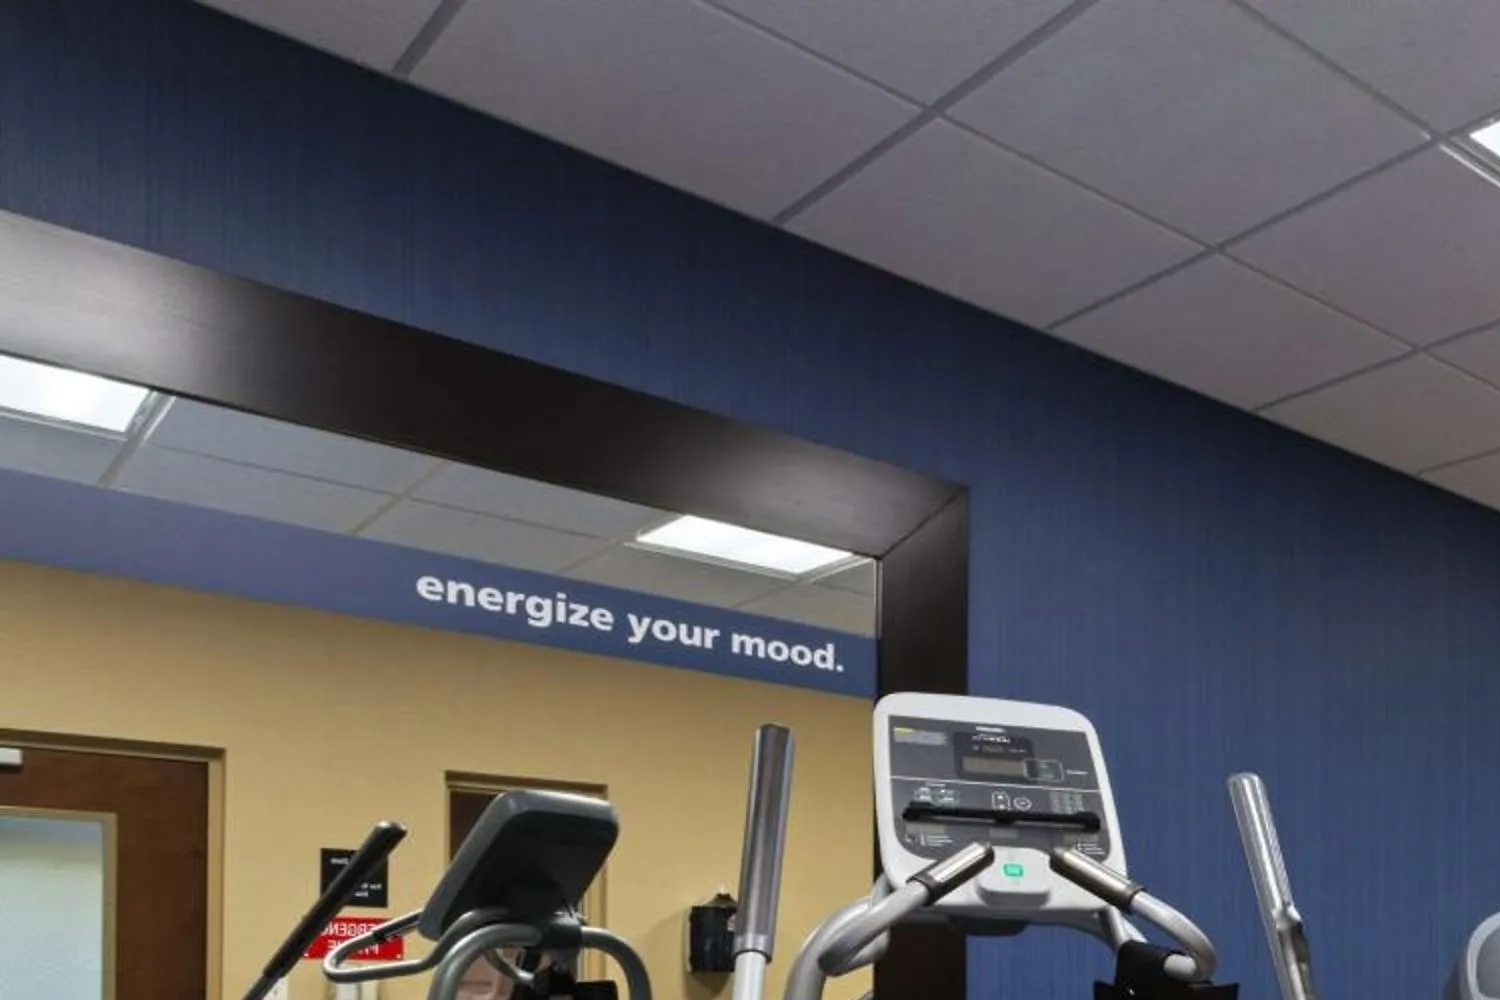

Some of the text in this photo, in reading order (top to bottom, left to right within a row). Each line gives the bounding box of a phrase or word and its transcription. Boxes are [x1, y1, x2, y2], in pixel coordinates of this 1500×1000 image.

[416, 575, 845, 672] energize your mood.
